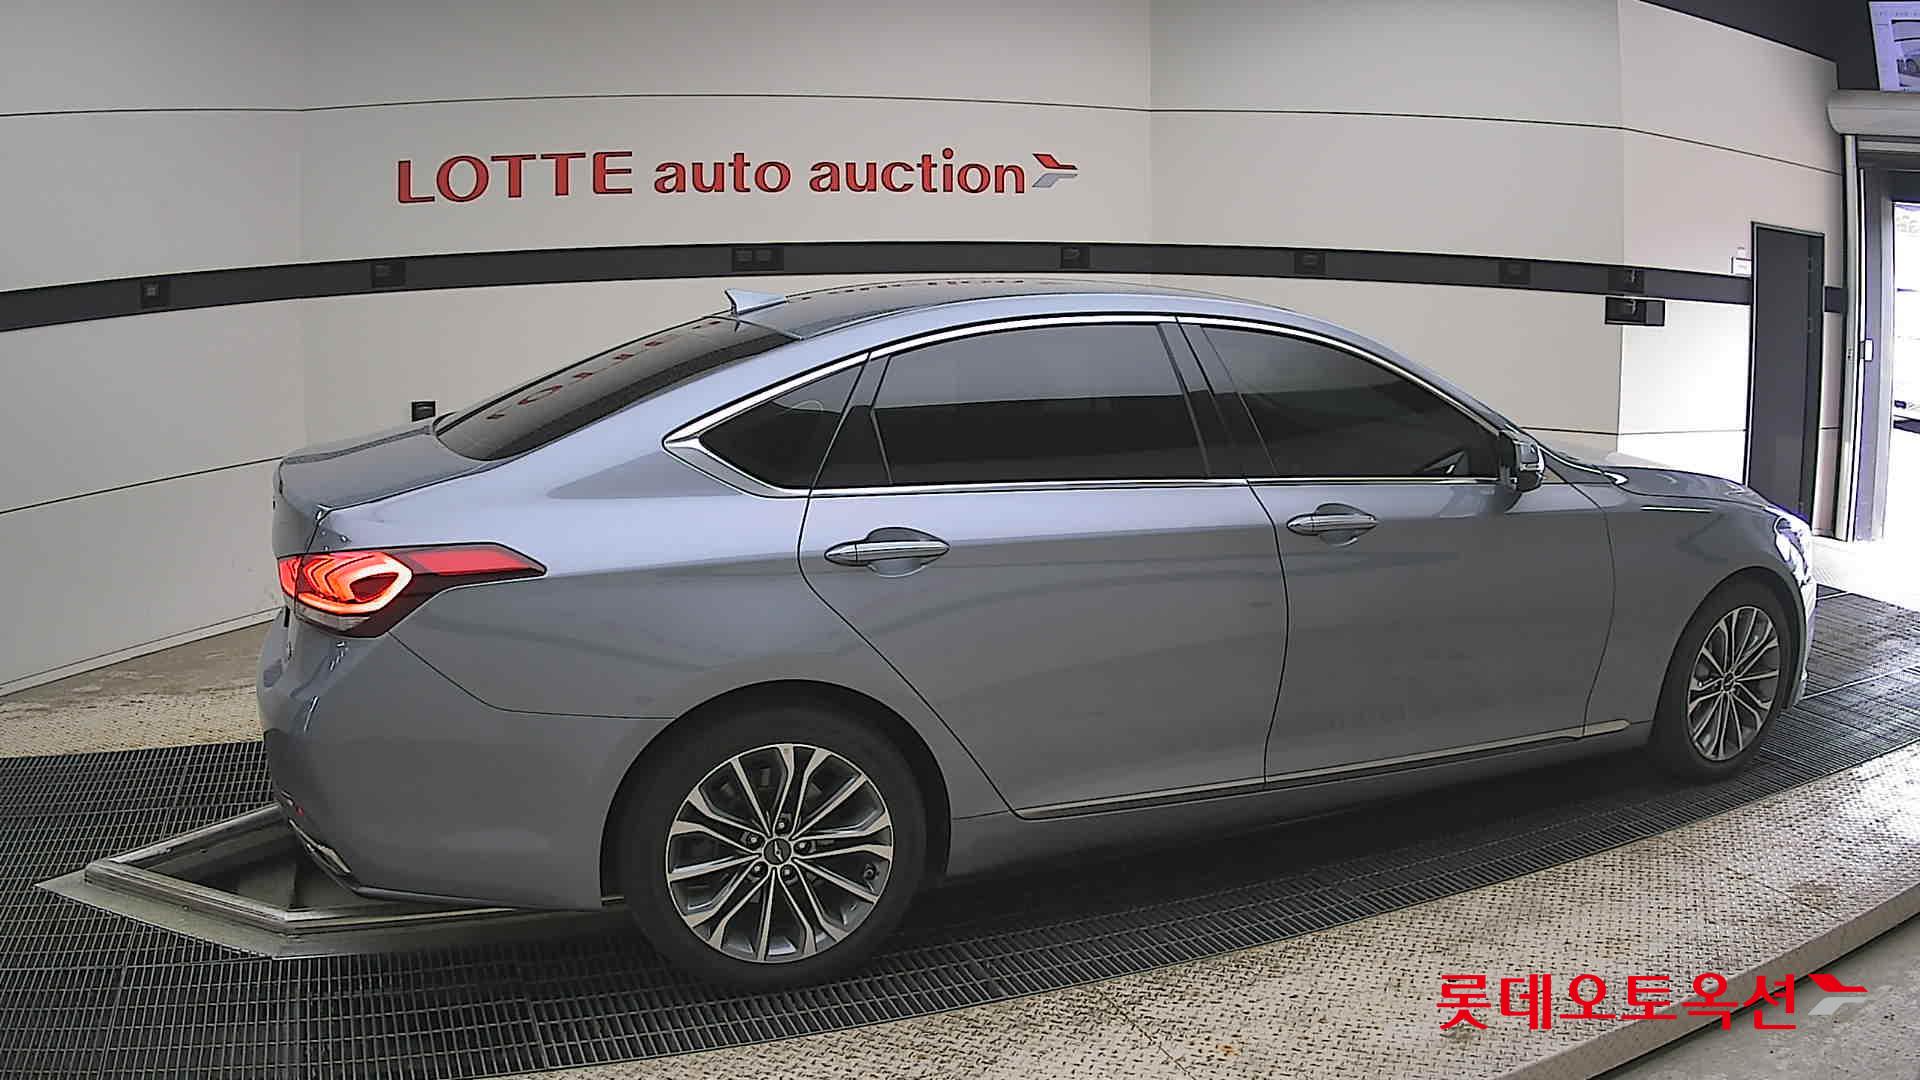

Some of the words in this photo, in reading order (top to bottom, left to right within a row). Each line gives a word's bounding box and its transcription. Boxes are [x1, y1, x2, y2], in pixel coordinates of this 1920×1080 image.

[398, 150, 632, 204] LOTTE
[654, 152, 791, 194] auto
[809, 147, 1026, 194] auction
